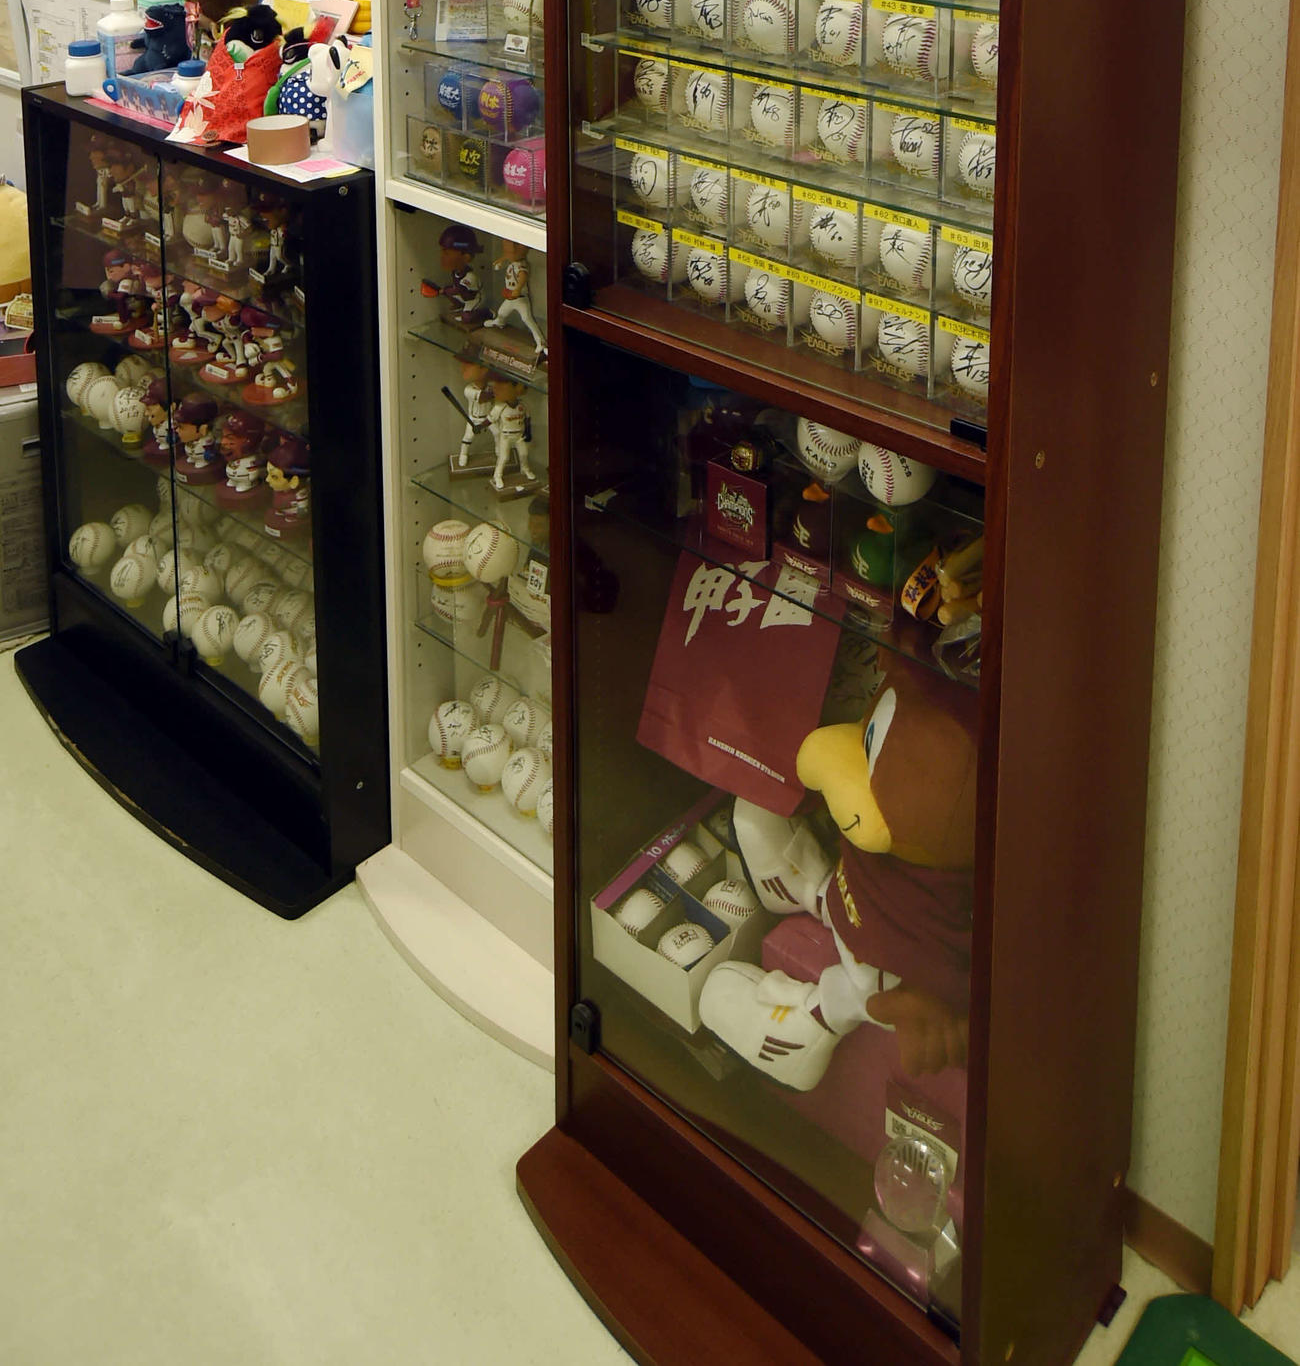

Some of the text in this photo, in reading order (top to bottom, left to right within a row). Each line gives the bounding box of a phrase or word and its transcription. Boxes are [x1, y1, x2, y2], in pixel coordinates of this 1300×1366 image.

[881, 0, 897, 10] #43
[874, 209, 889, 219] #62
[950, 232, 969, 244] #63
[805, 336, 843, 356] EAGLES
[875, 360, 914, 383] EAGLES
[805, 445, 837, 469] KANO
[682, 558, 824, 647] 甲子園
